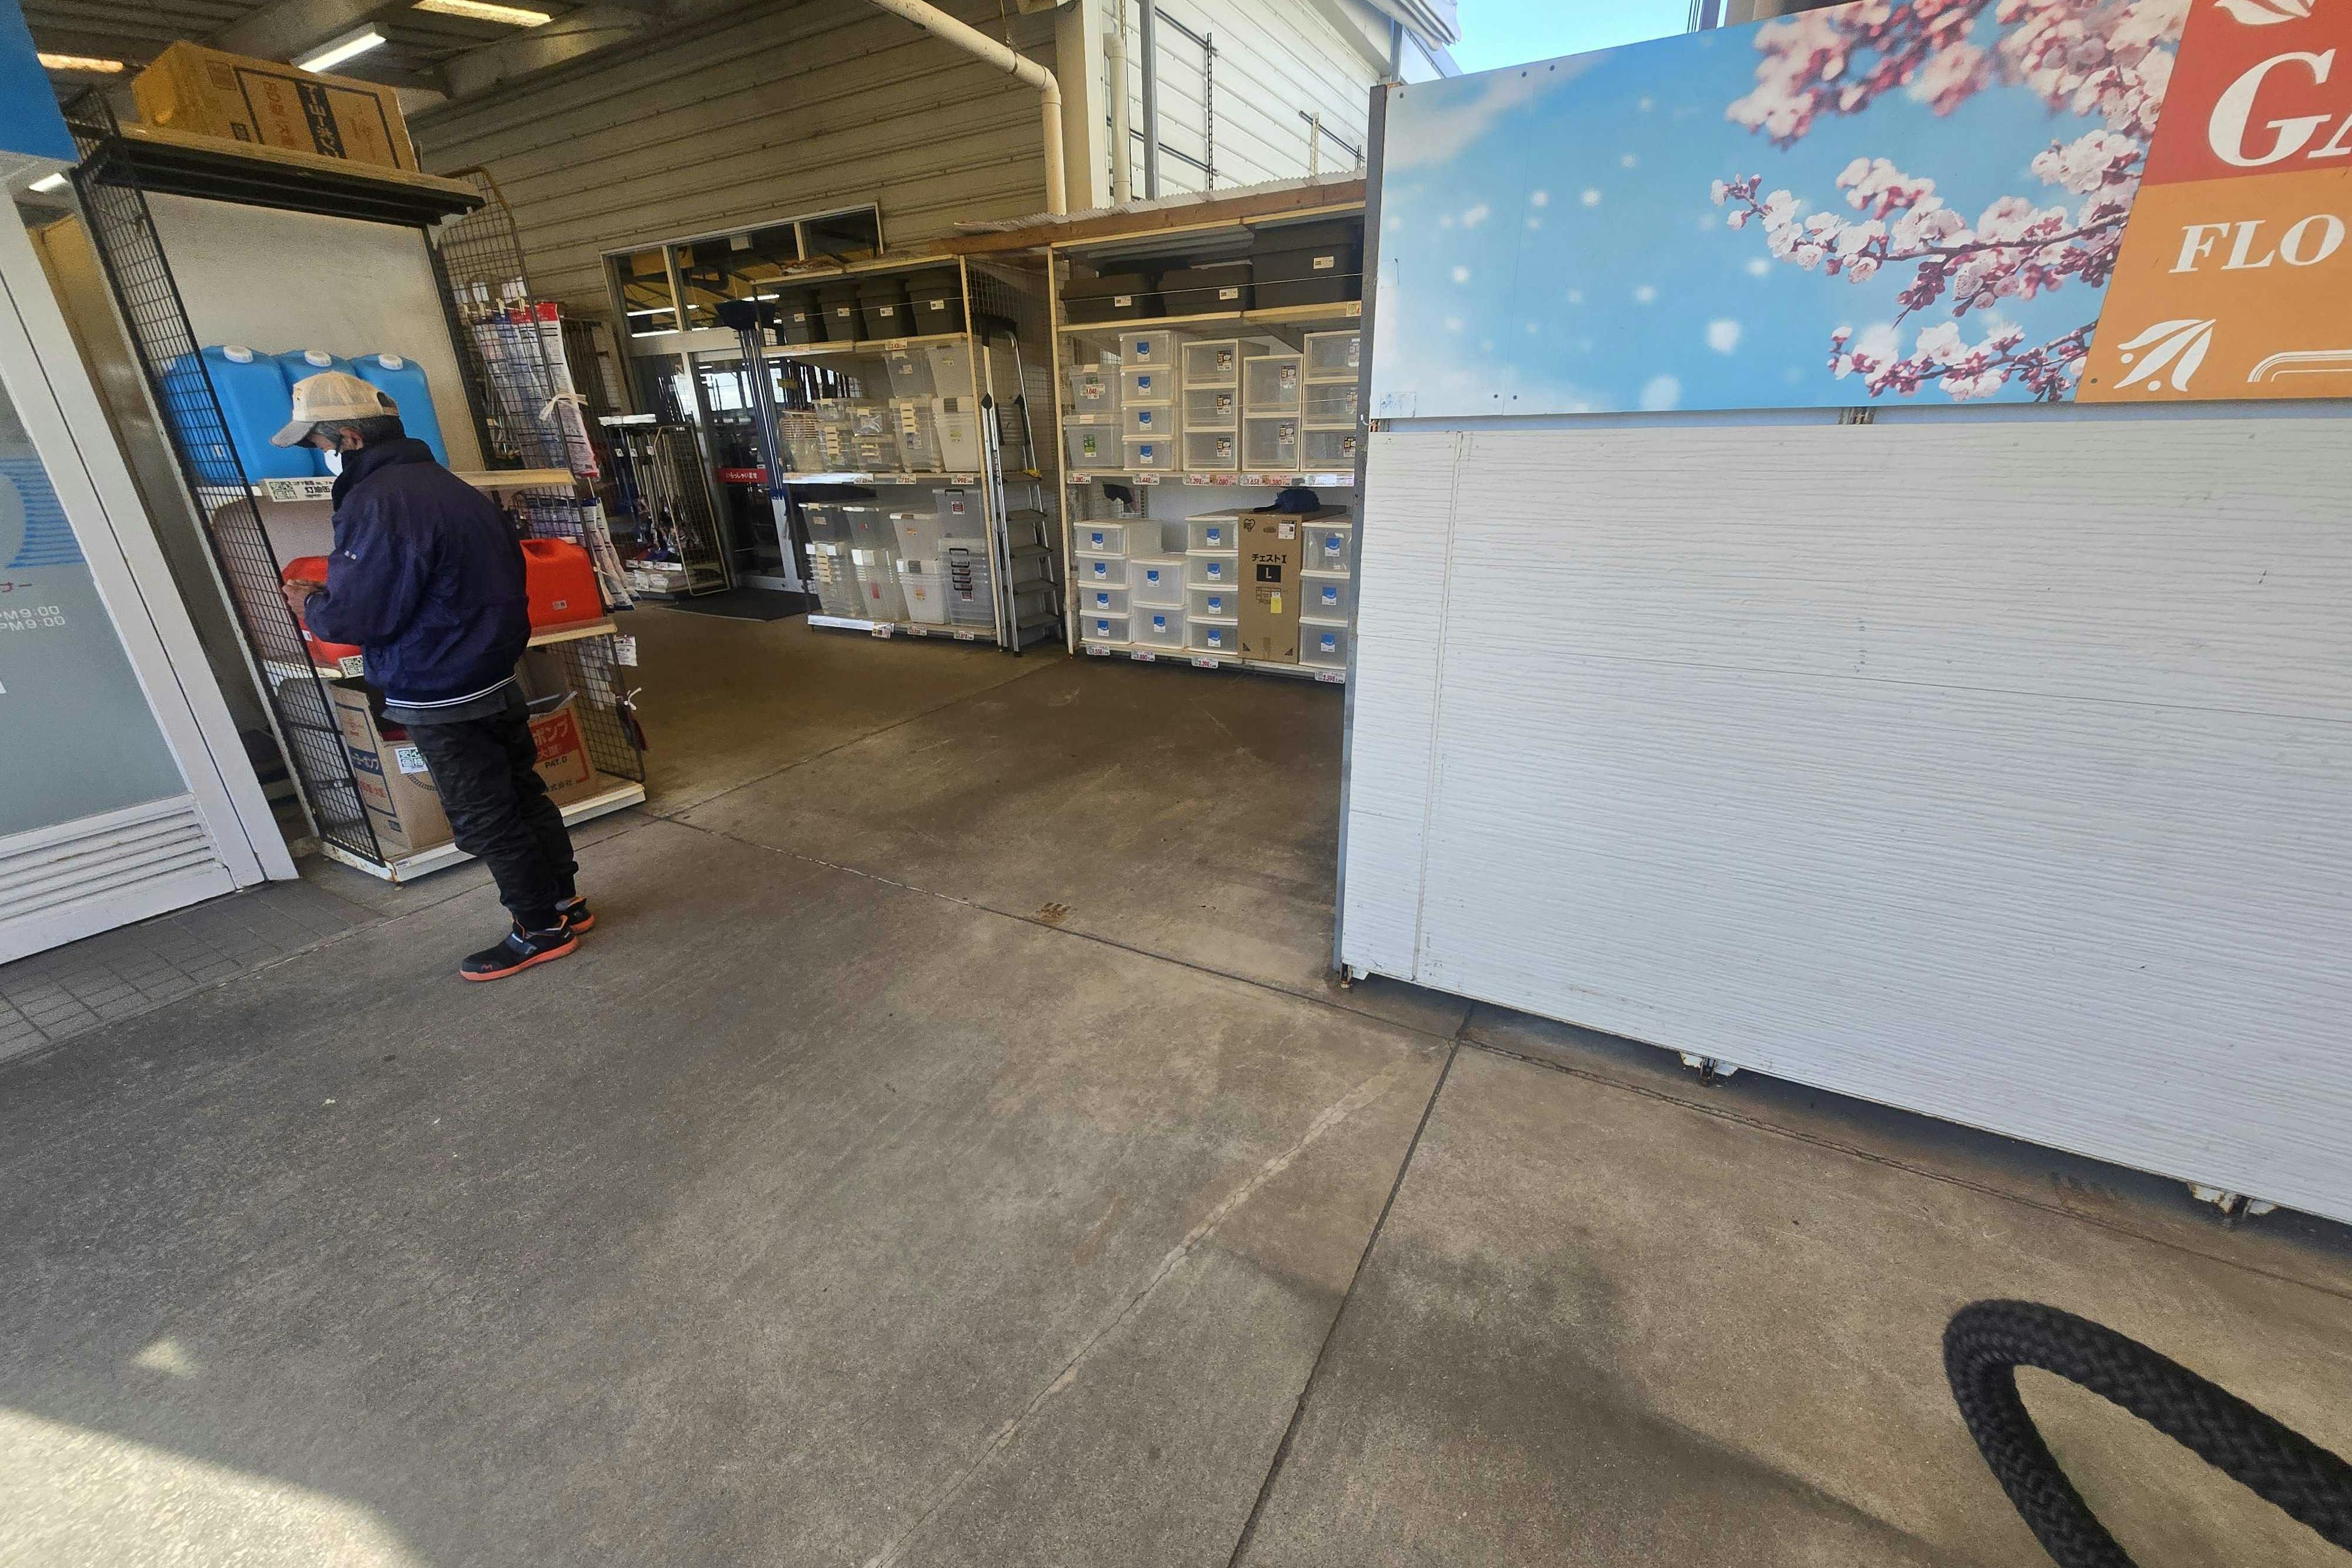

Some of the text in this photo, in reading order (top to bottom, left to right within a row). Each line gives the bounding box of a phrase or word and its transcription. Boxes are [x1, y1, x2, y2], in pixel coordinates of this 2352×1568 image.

[2169, 214, 2346, 273] FLO
[1265, 567, 1272, 579] L
[0, 606, 60, 621] M9:00
